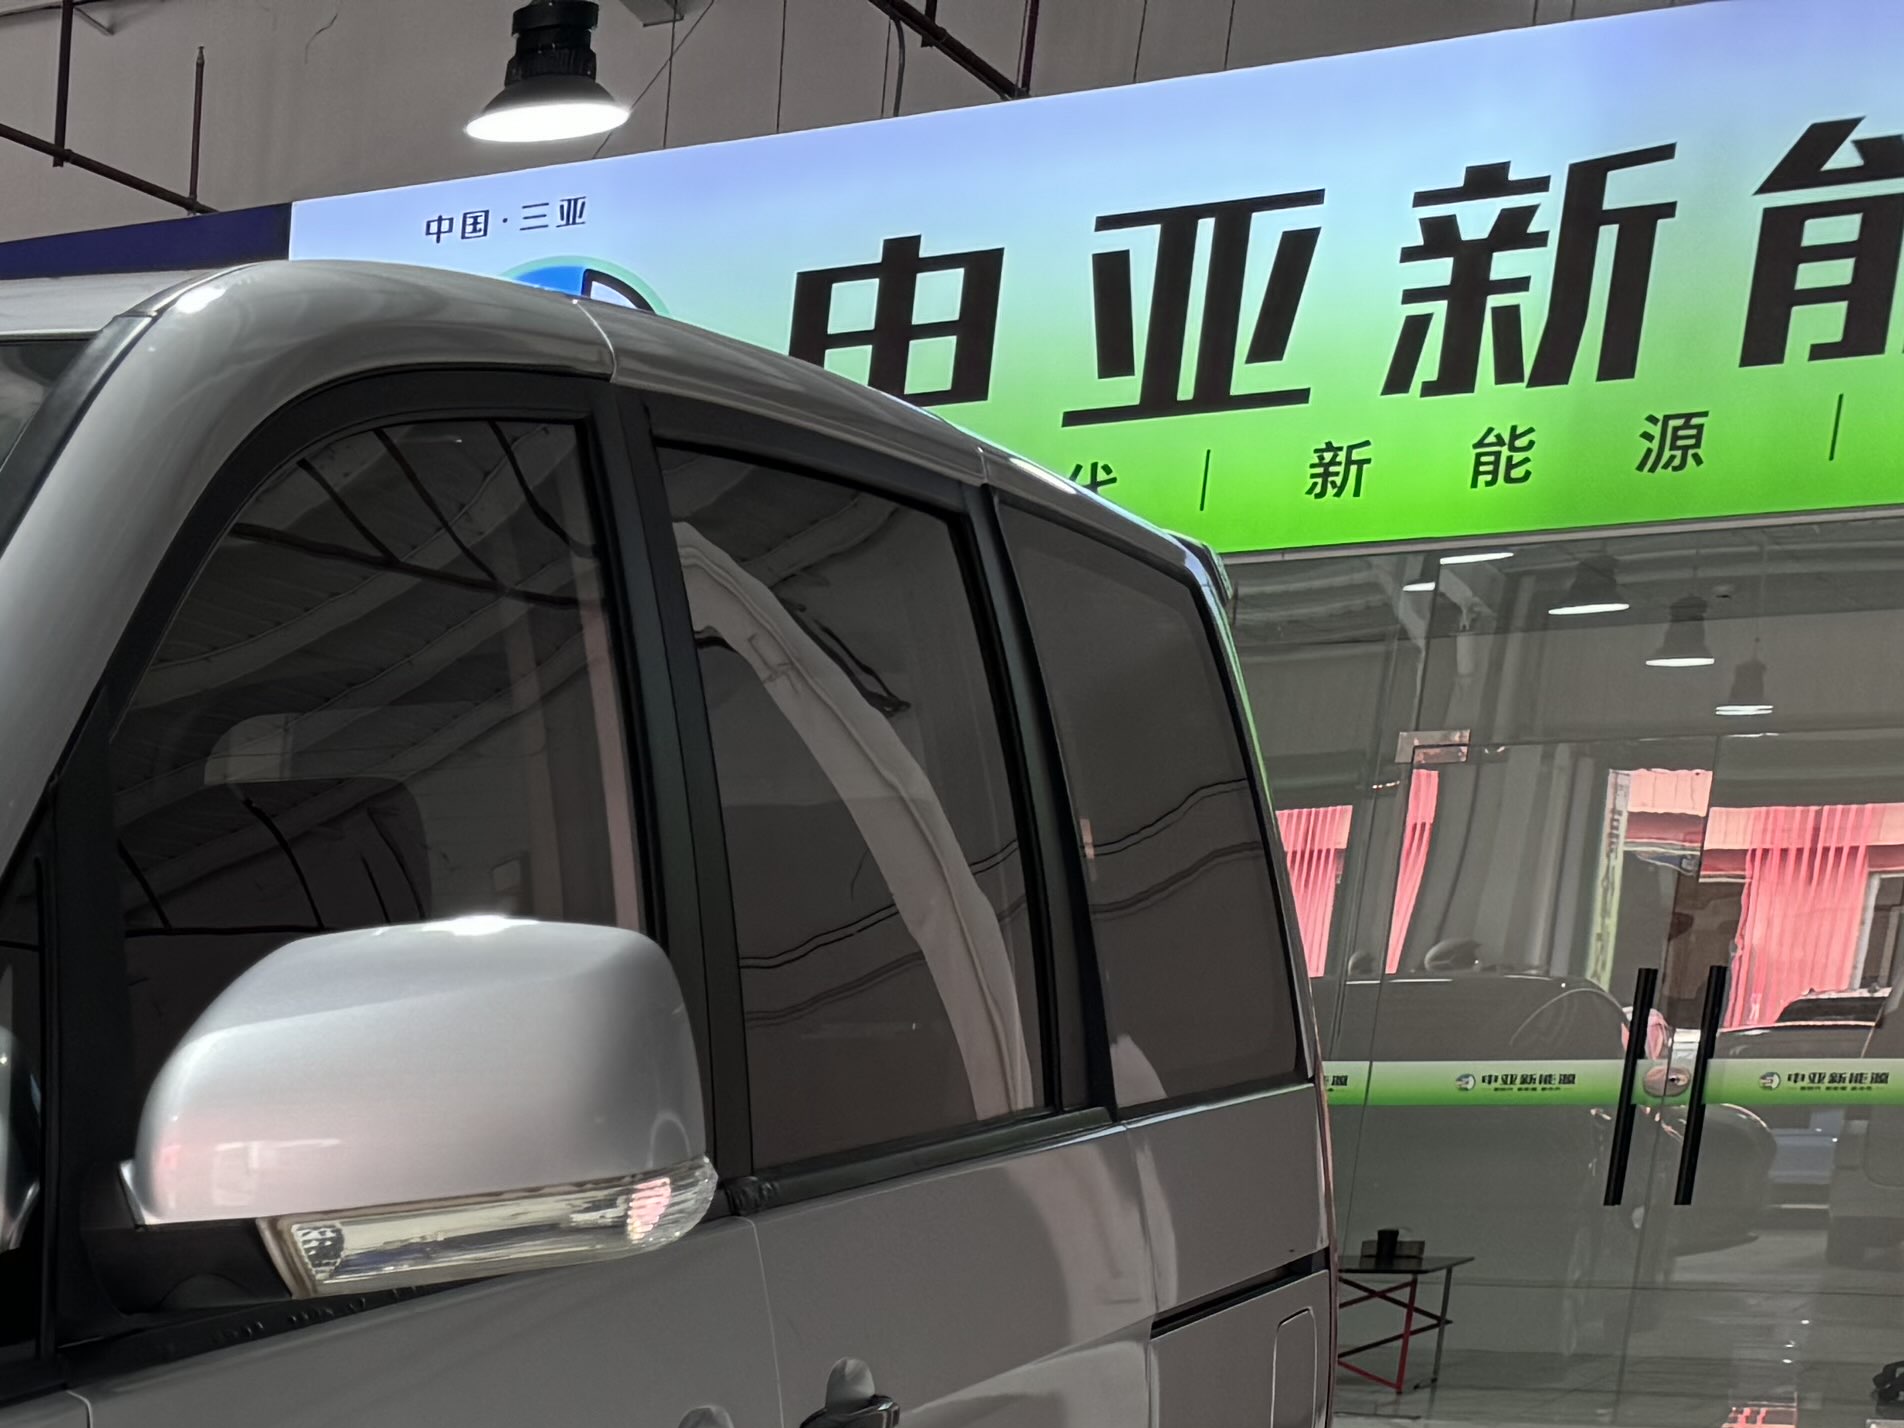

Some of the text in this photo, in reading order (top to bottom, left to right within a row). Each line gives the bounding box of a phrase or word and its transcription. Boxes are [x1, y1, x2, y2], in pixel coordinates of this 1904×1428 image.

[424, 196, 587, 244] 中国·三亚
[1304, 410, 1710, 499] 新能源
